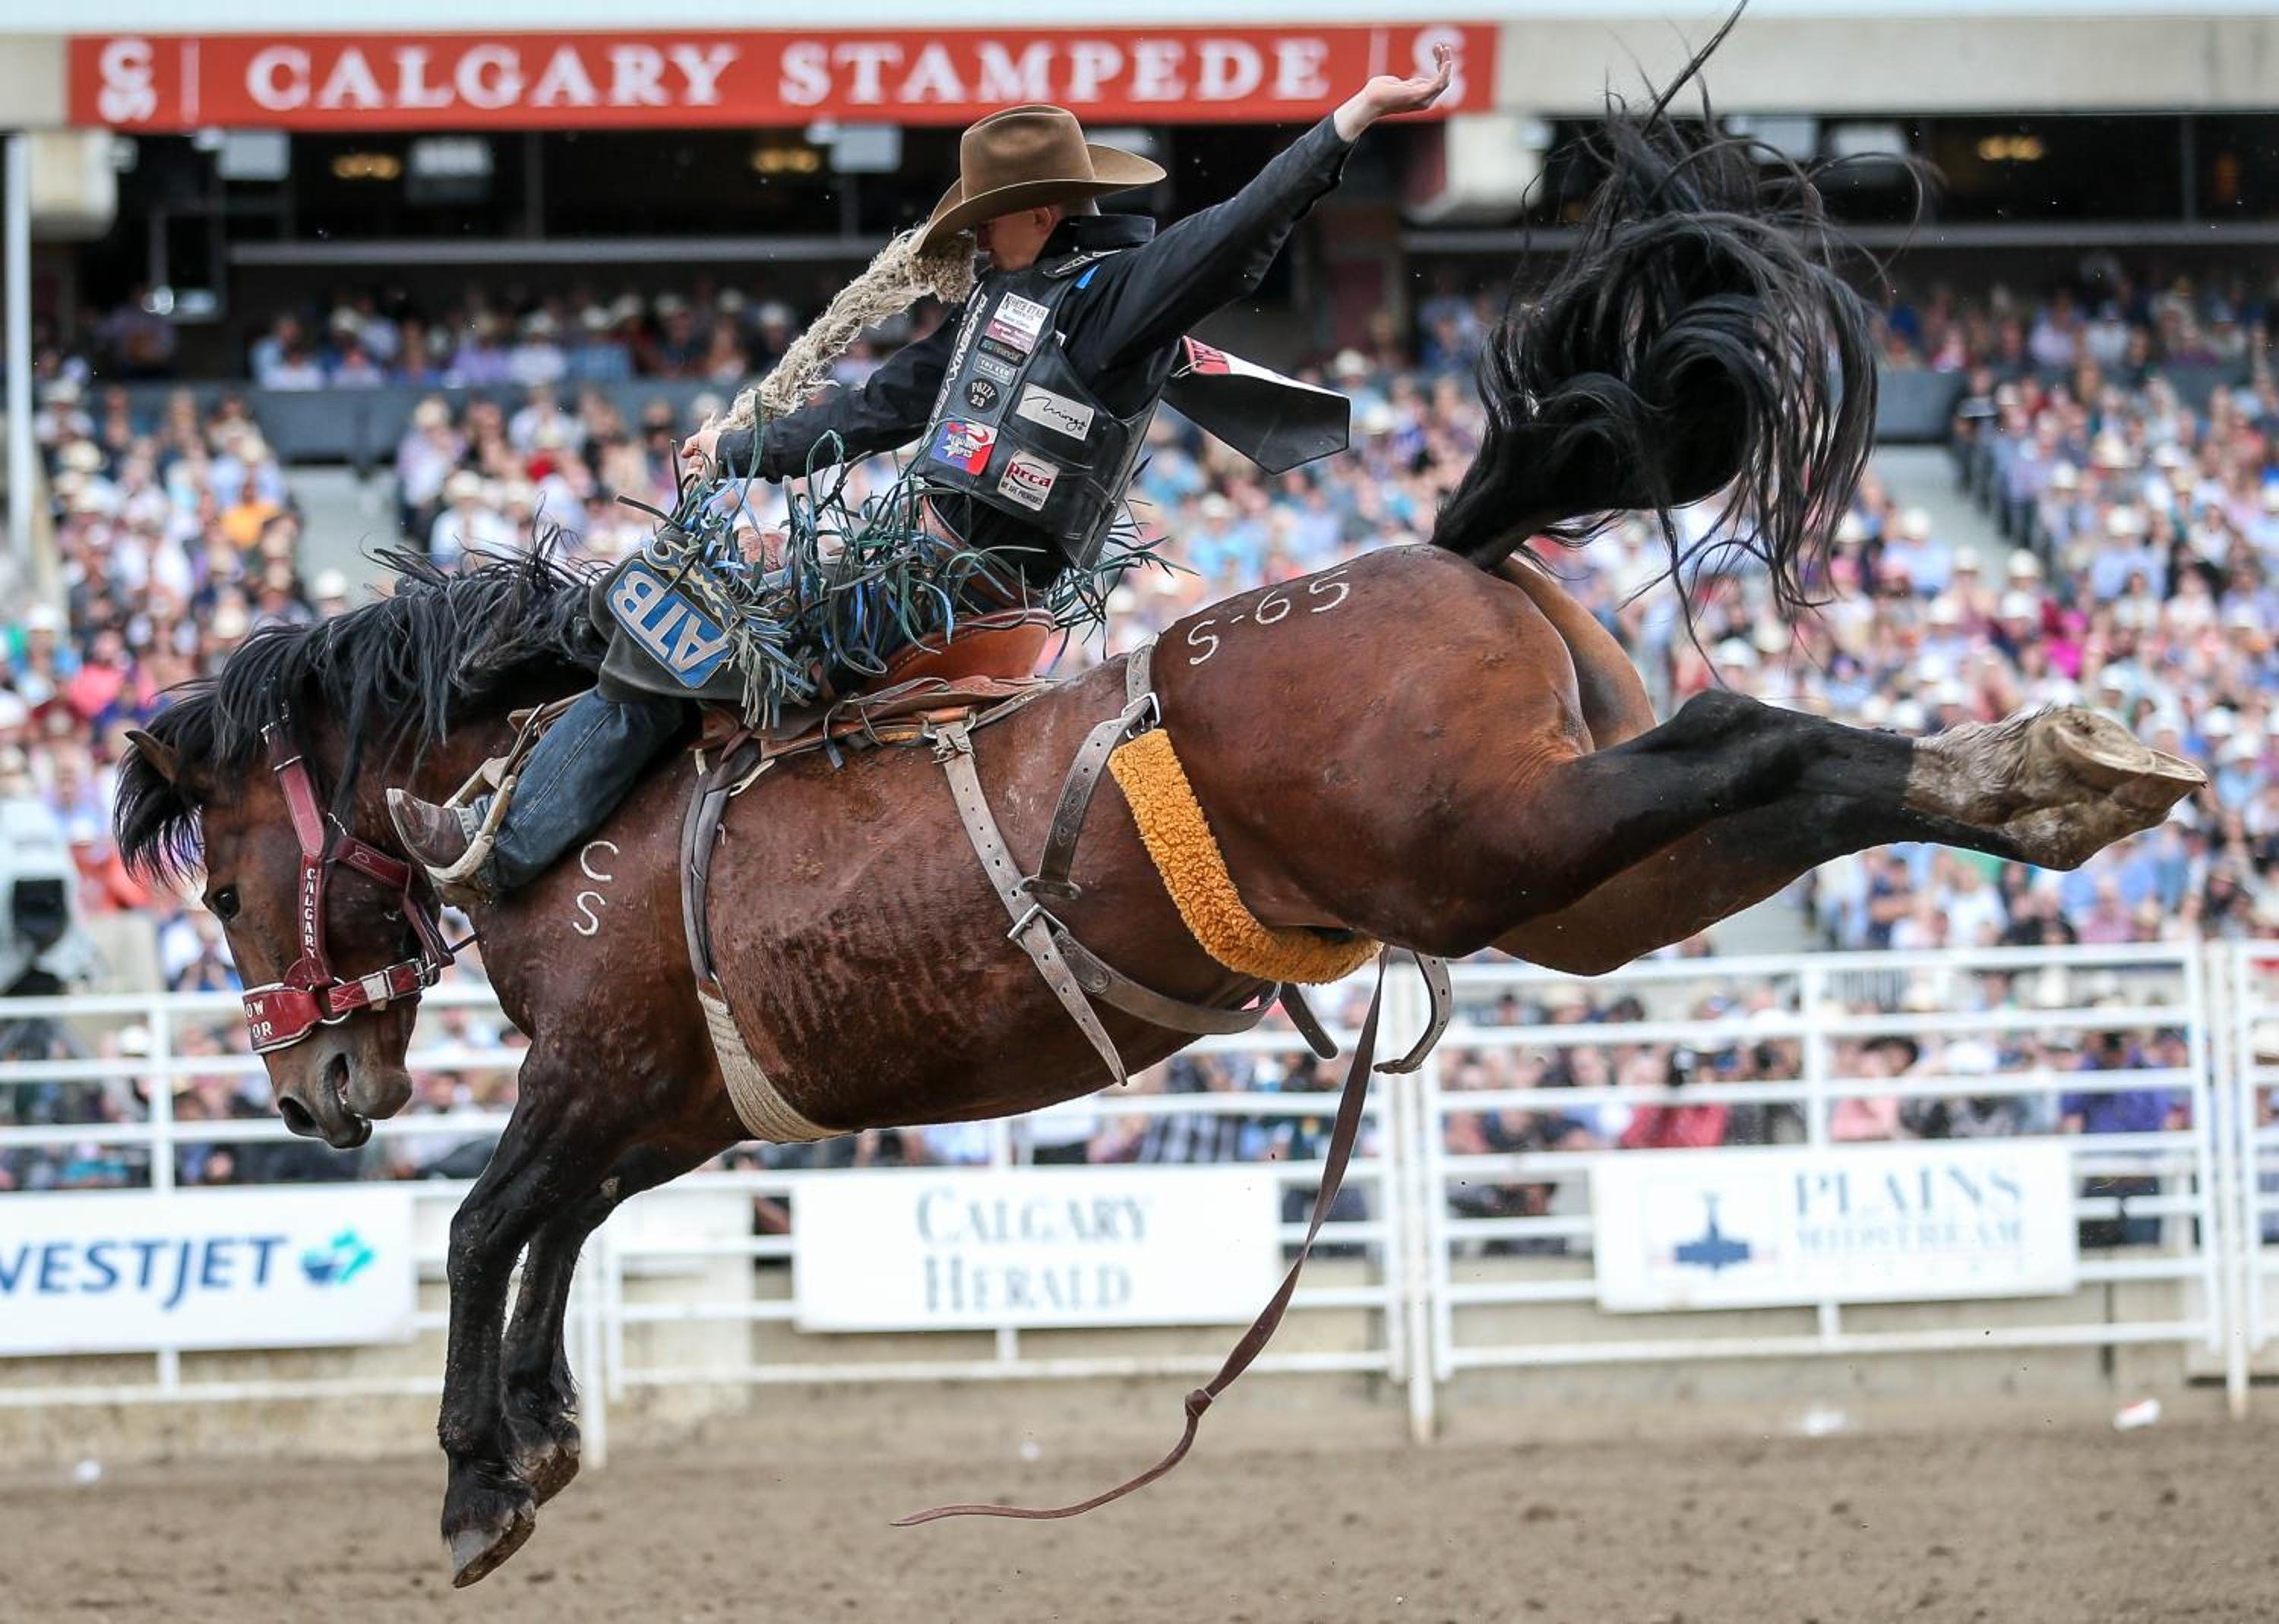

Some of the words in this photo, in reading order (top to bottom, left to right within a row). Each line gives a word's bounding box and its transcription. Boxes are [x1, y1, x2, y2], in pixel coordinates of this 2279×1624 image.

[245, 43, 739, 112] CALGARY
[780, 37, 1331, 106] STAMPEDE
[970, 394, 986, 408] 23
[972, 381, 997, 400] POZZY
[1005, 460, 1052, 487] prca
[613, 570, 729, 673] ATB
[304, 867, 317, 959] CALGARY
[1794, 1162, 2026, 1217] PLAINS
[922, 1253, 1133, 1313] HERALD
